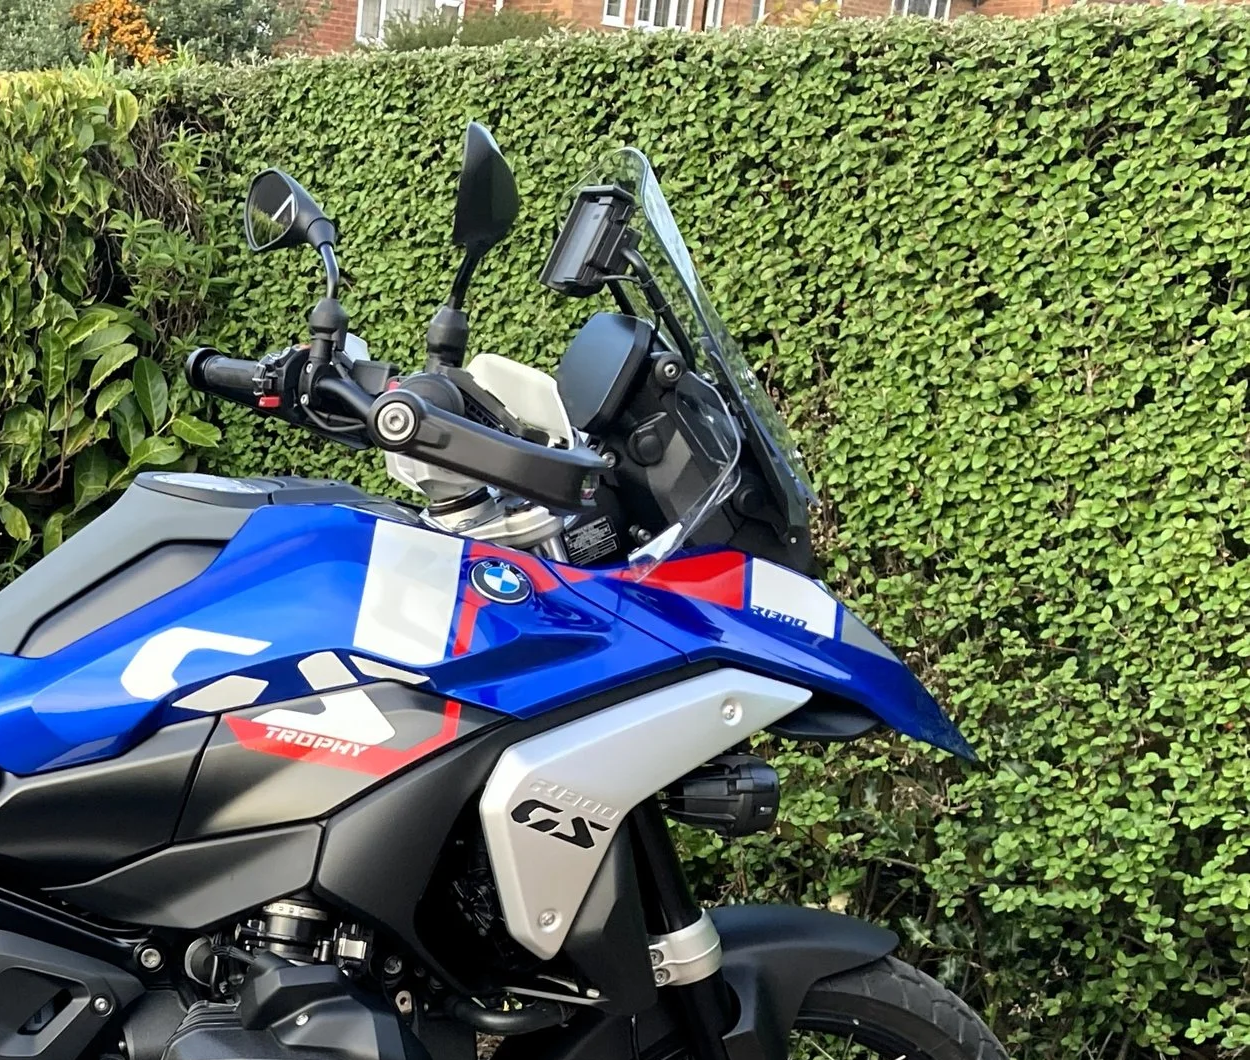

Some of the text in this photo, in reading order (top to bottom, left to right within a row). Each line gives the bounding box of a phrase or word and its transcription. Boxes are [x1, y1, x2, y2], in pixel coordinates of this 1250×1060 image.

[481, 561, 526, 582] BMW
[264, 725, 371, 757] TROPHY
[510, 799, 611, 849] GS
